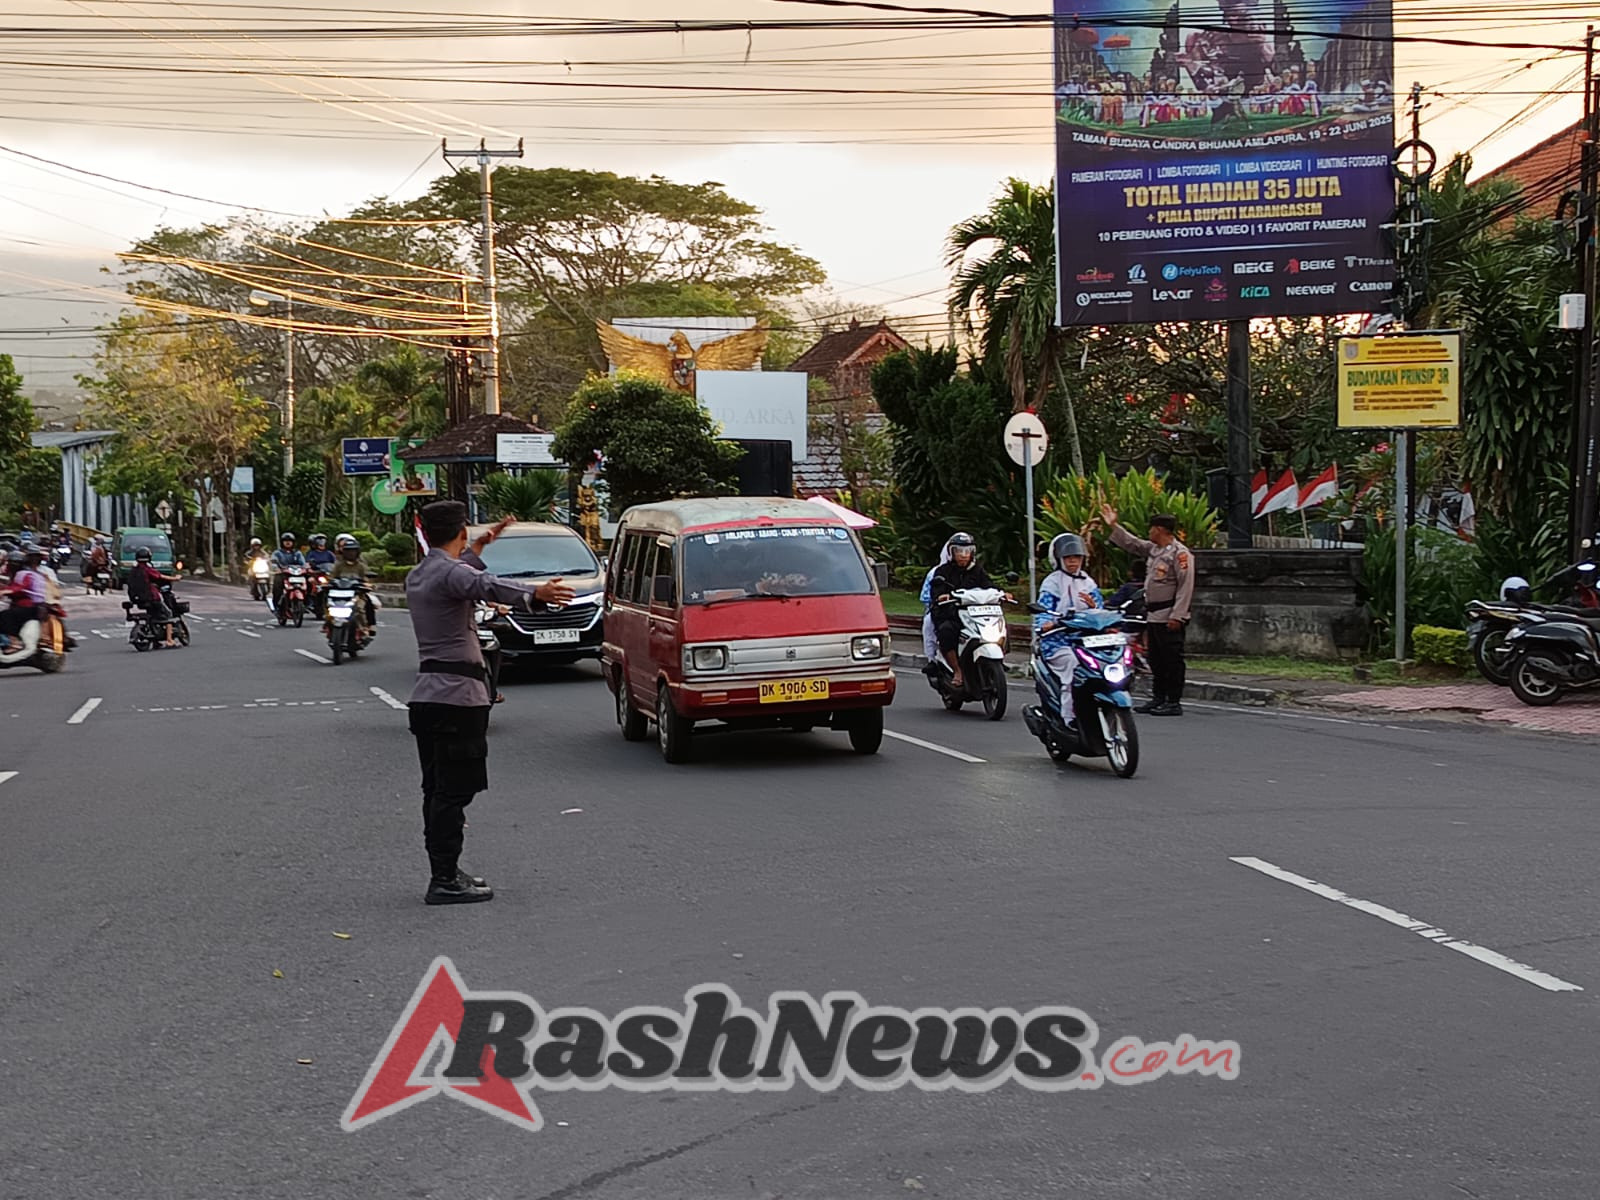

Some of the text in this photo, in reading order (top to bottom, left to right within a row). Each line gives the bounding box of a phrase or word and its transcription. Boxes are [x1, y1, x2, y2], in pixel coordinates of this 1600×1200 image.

[1072, 132, 1107, 145] TAMAN
[1109, 138, 1151, 149] BUDAYA
[1152, 140, 1196, 150] CANDRA
[1199, 138, 1243, 150] BHUANA
[1309, 130, 1320, 139] 19
[1329, 126, 1341, 136] 22
[1343, 121, 1367, 133] JUNI
[1369, 114, 1393, 128] 2025
[1071, 171, 1104, 183] PAMERAN
[1105, 168, 1143, 181] FOTOGRAFI
[1157, 165, 1182, 178] LOMBA
[1183, 164, 1221, 177] FOTOGRAFI
[1235, 161, 1260, 174] LOMBA
[1261, 160, 1302, 172] VIDEOGRAFI
[1316, 157, 1347, 169] HUNTING
[1348, 155, 1388, 168] FOTOGRAFI
[1123, 176, 1341, 207] TOTAL HADIAH 35 JUTA
[1157, 209, 1192, 223] PIALA
[1194, 206, 1236, 221] BUPATI
[1239, 202, 1322, 219] KARANGASEM
[1098, 232, 1110, 241] 10
[1112, 229, 1172, 240] PEMENANG
[1174, 227, 1203, 237] FOTO
[1205, 226, 1214, 236] &
[1216, 224, 1249, 235] VIDEO
[1265, 221, 1311, 232] FAVORIT
[1313, 219, 1366, 230] PAMERAN
[1153, 288, 1193, 301] Lexar
[1349, 281, 1392, 292] Canon
[1347, 367, 1449, 387] BUDAYAKAN PRINSIP 3R
[743, 407, 795, 424] ARKA
[761, 680, 826, 696] DK 1906 SD
